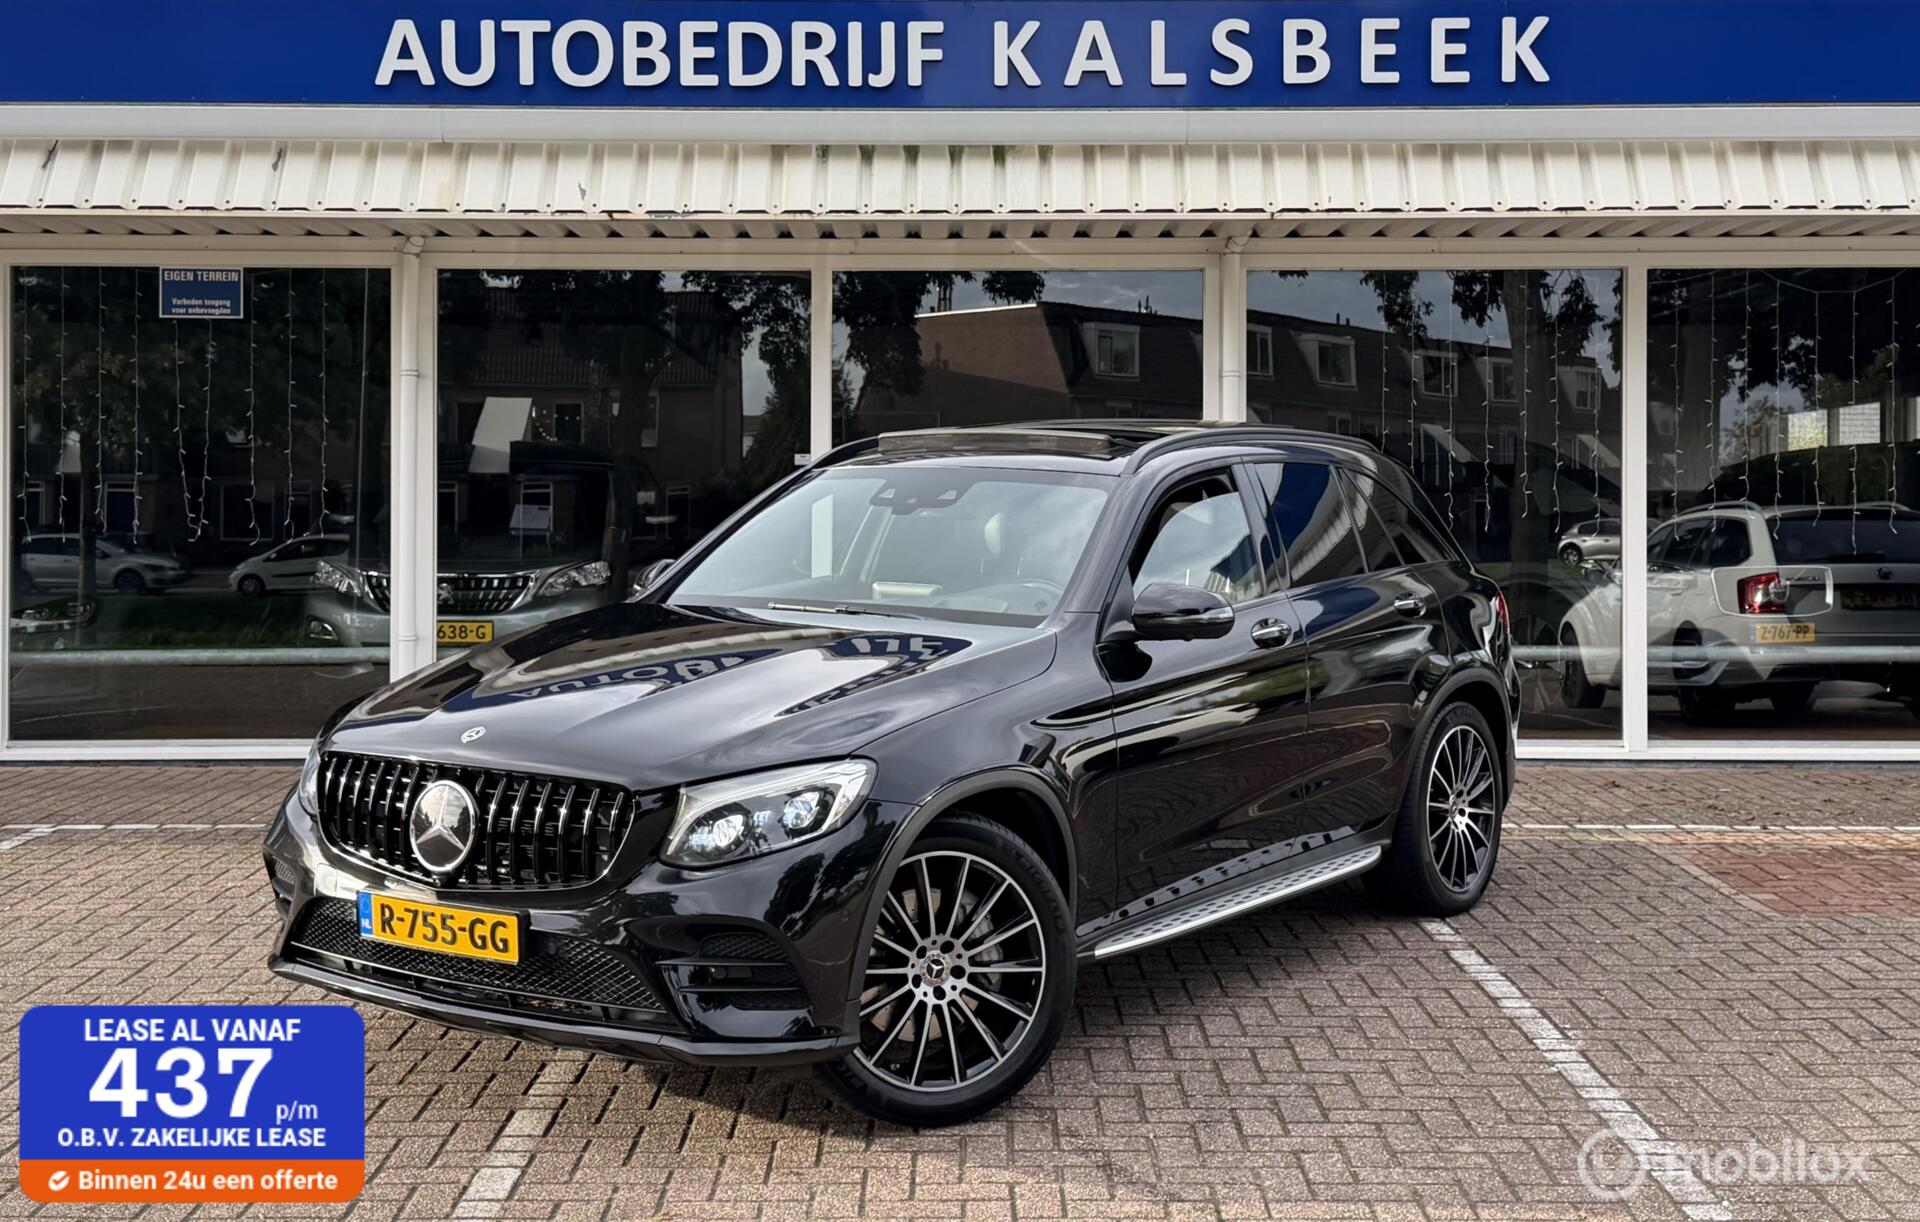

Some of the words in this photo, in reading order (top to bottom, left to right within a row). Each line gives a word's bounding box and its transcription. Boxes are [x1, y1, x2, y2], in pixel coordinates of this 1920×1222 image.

[375, 19, 945, 88] AUTOBEDRIJF
[993, 15, 1551, 87] KALSBEEK
[164, 270, 194, 281] EIGEN
[196, 271, 239, 282] TERREIN
[1760, 624, 1810, 641] Z-767-PP
[379, 902, 509, 954] R-755-GG
